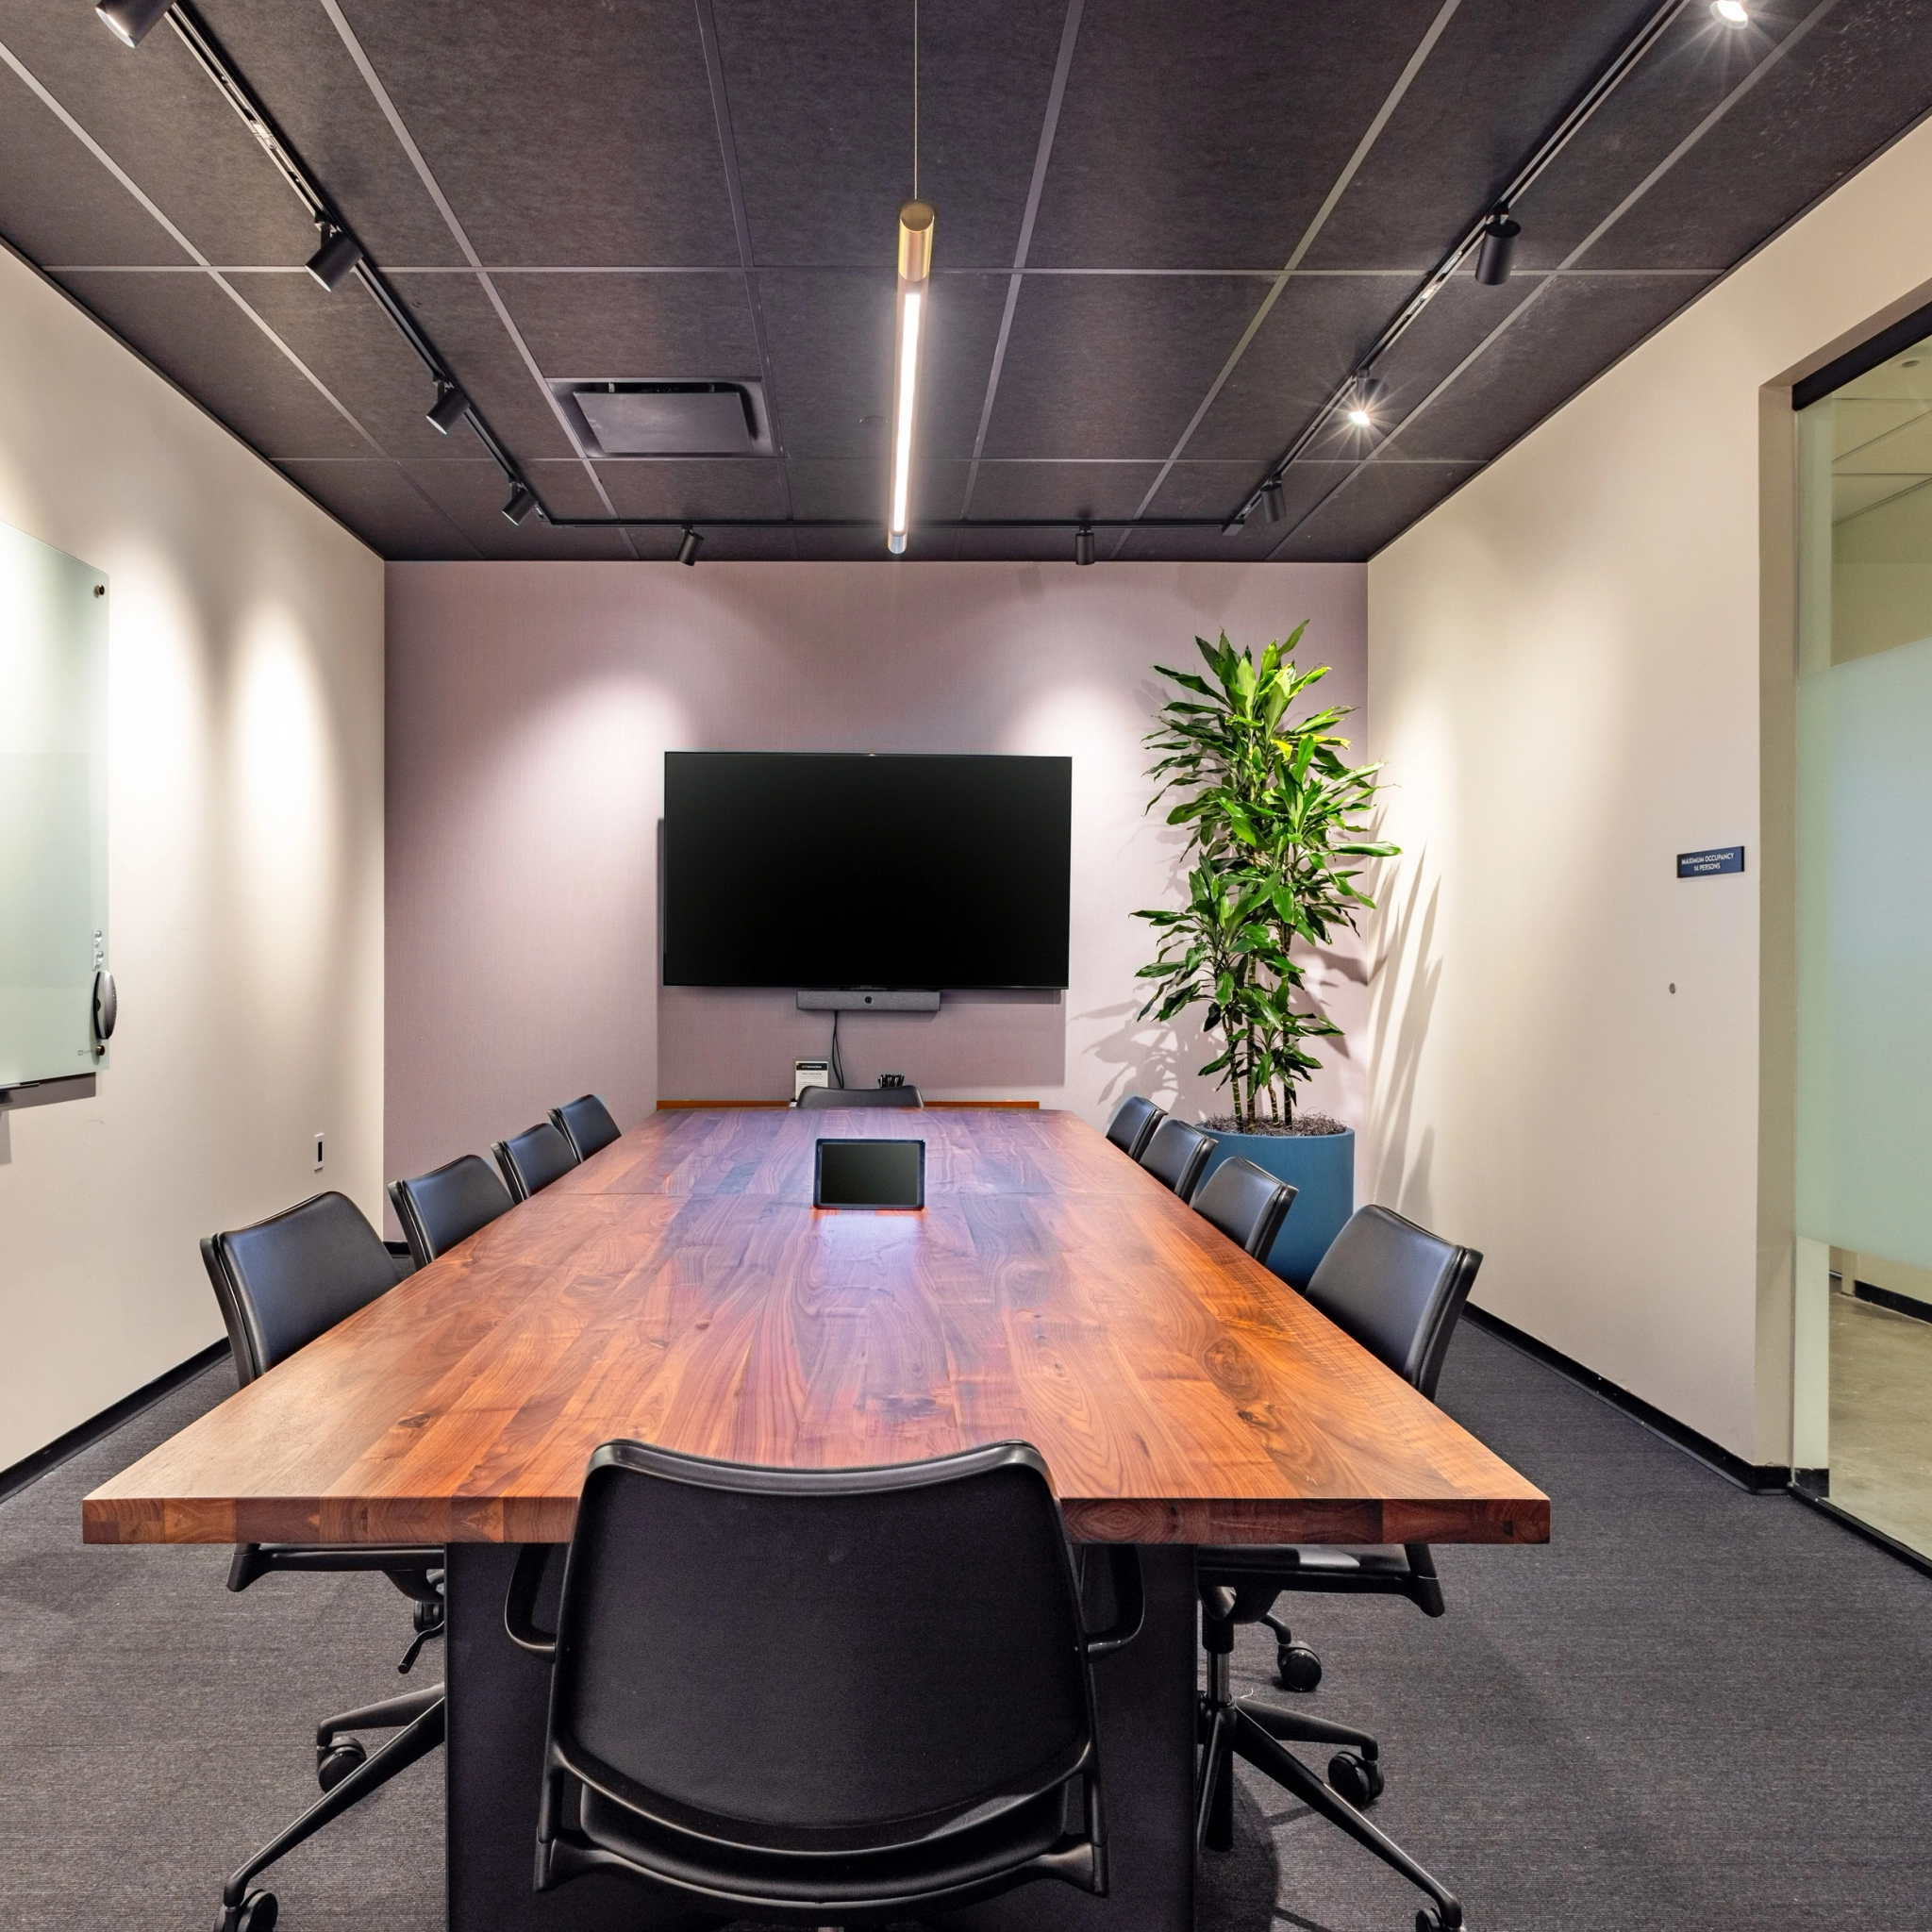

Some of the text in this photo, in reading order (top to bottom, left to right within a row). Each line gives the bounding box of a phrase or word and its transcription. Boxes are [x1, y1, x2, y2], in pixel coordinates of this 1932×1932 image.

[1681, 852, 1735, 865] MAXIMUM OCCUPANCY
[1699, 863, 1721, 871] PERSONS
